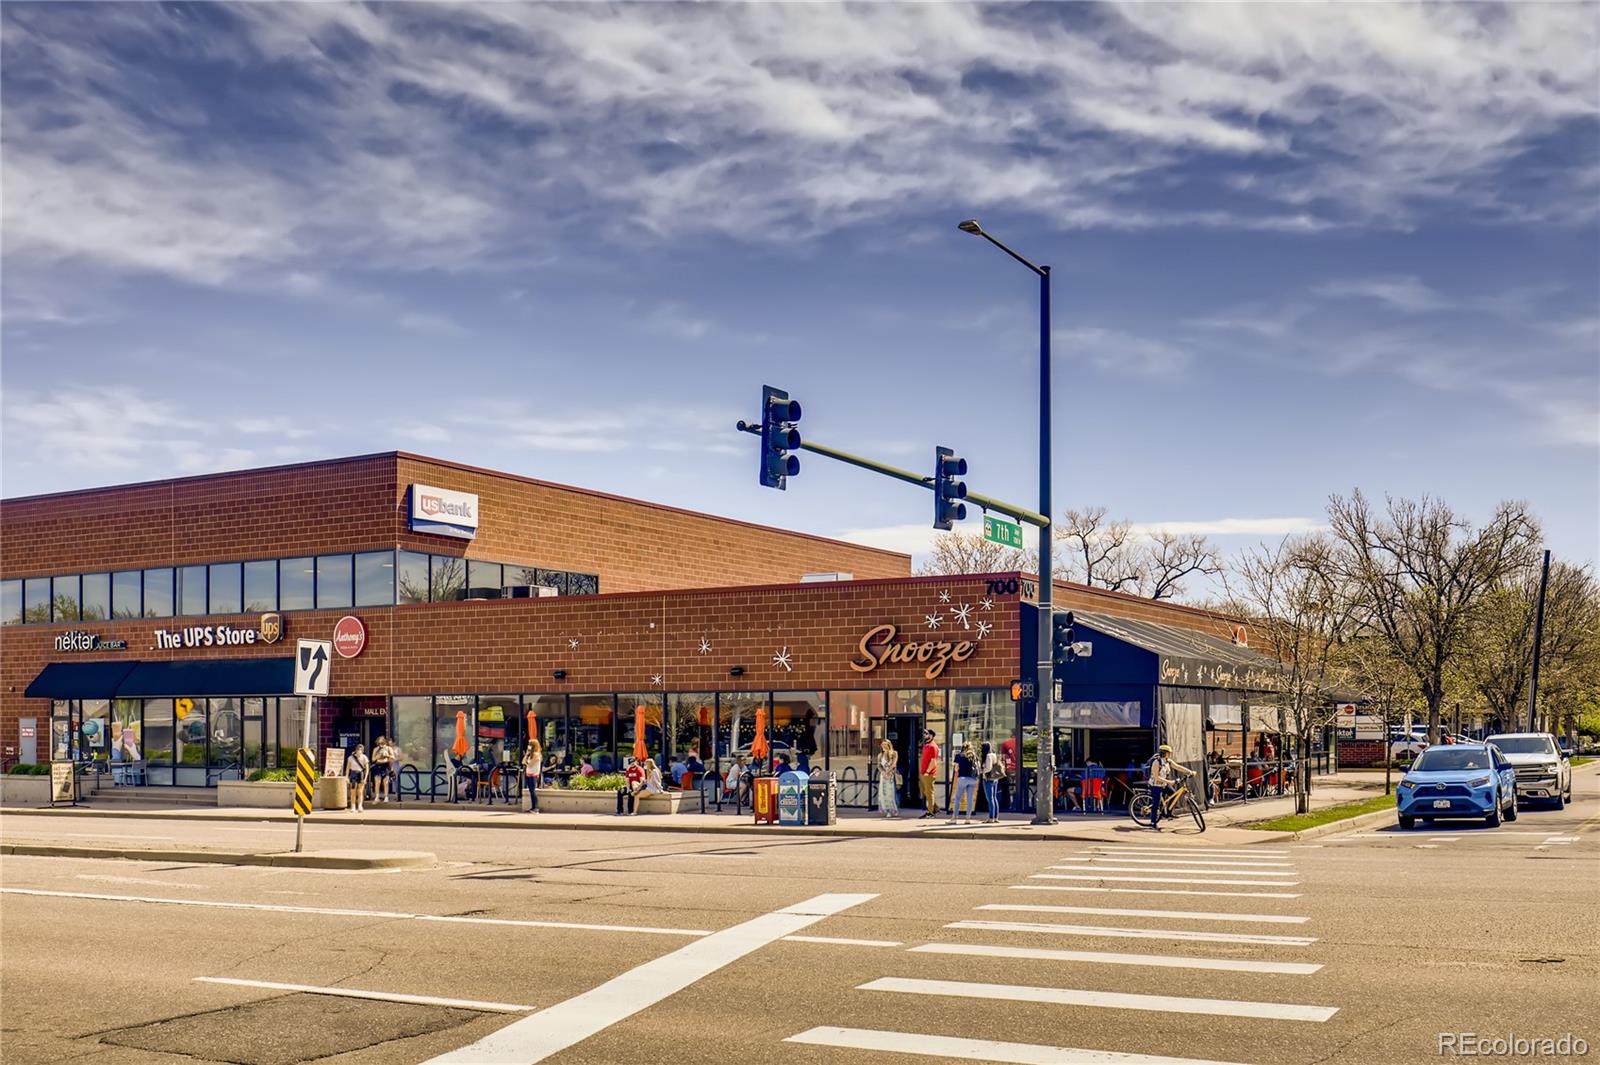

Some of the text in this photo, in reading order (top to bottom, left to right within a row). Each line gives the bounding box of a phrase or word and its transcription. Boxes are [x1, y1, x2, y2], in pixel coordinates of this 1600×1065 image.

[996, 523, 1010, 541] 7th
[985, 579, 1018, 596] 700
[154, 625, 255, 649] The UPS Store
[850, 624, 975, 680] Snooze
